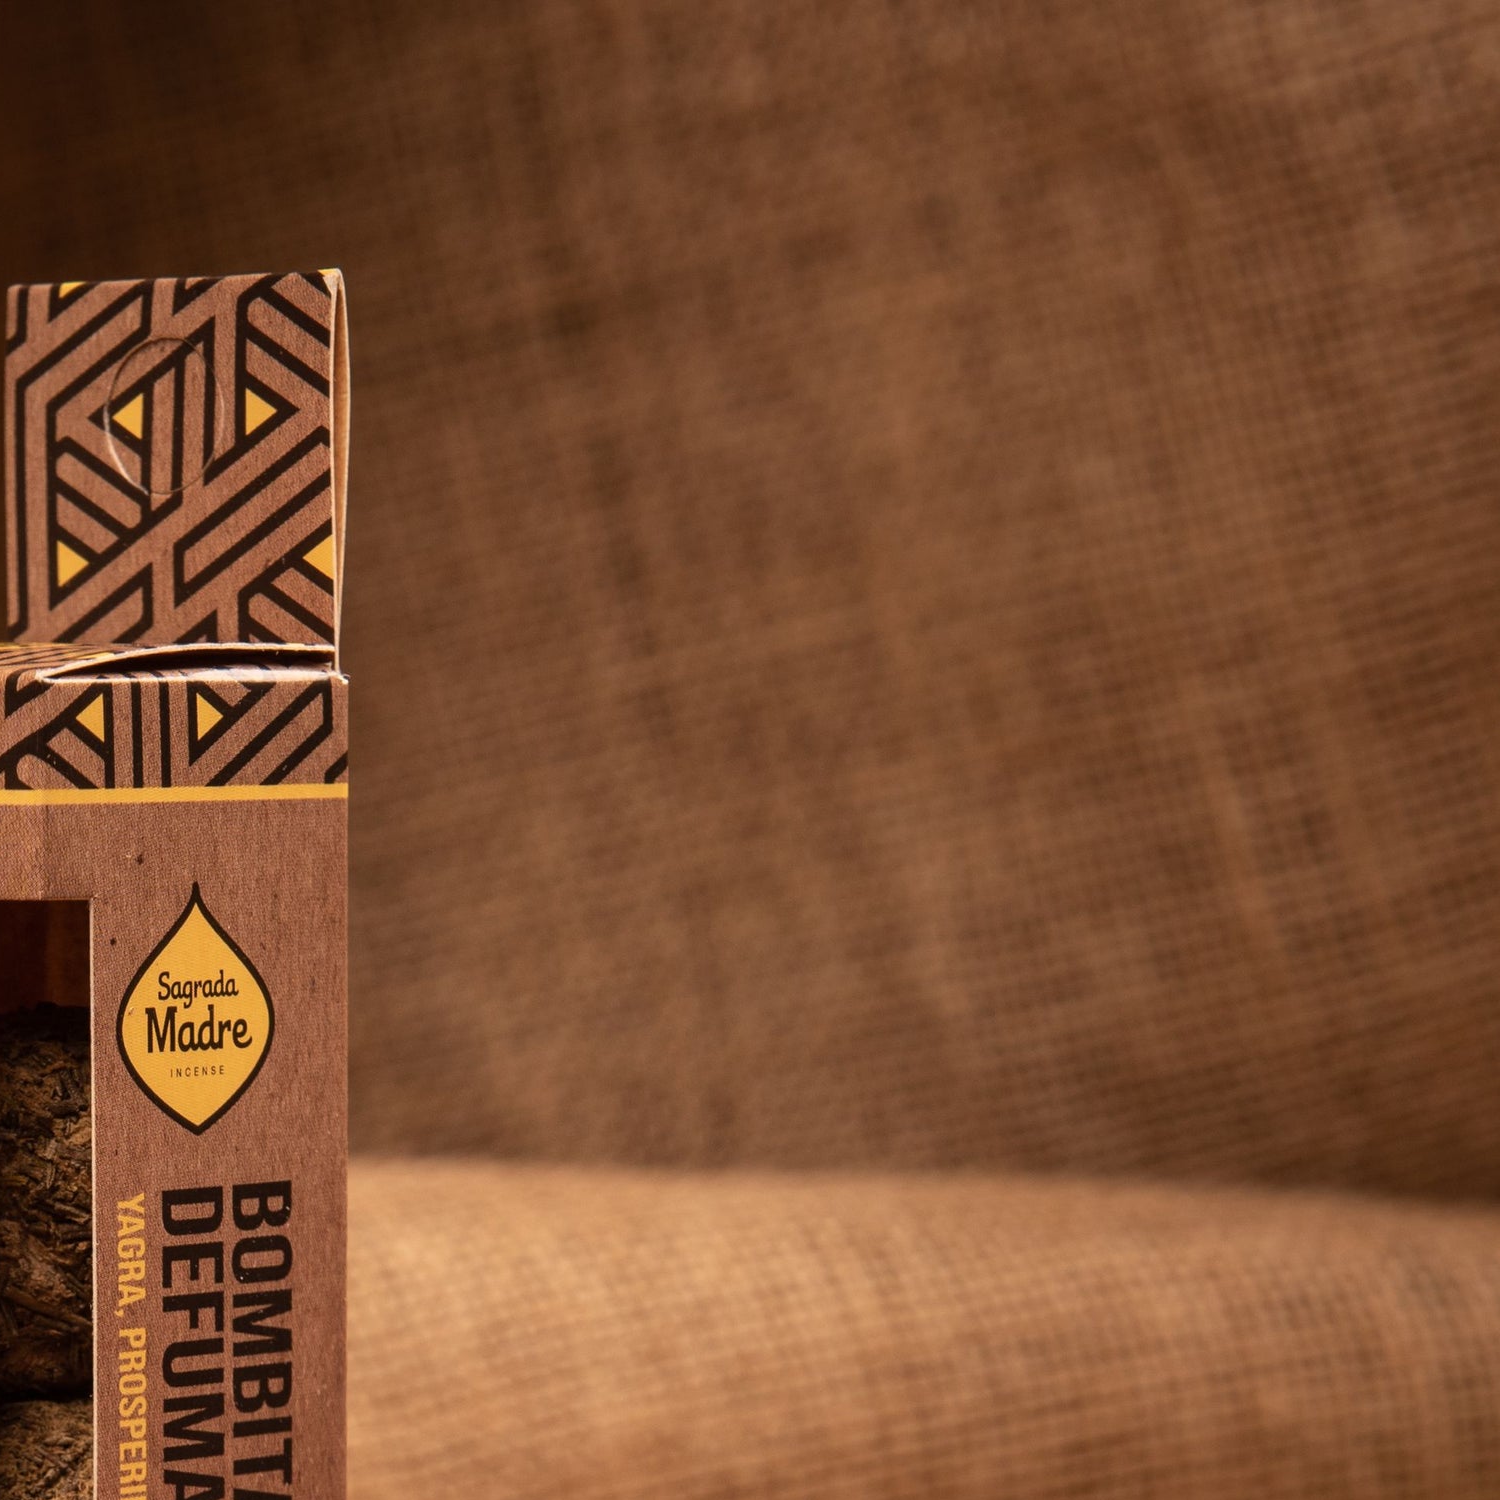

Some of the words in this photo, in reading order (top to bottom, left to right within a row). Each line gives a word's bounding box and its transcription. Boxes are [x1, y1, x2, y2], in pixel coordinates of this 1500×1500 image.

[157, 969, 239, 1008] Sagrada
[145, 1004, 253, 1053] Madre
[170, 1065, 225, 1078] INCENSE
[114, 1193, 146, 1318] YAGRA,
